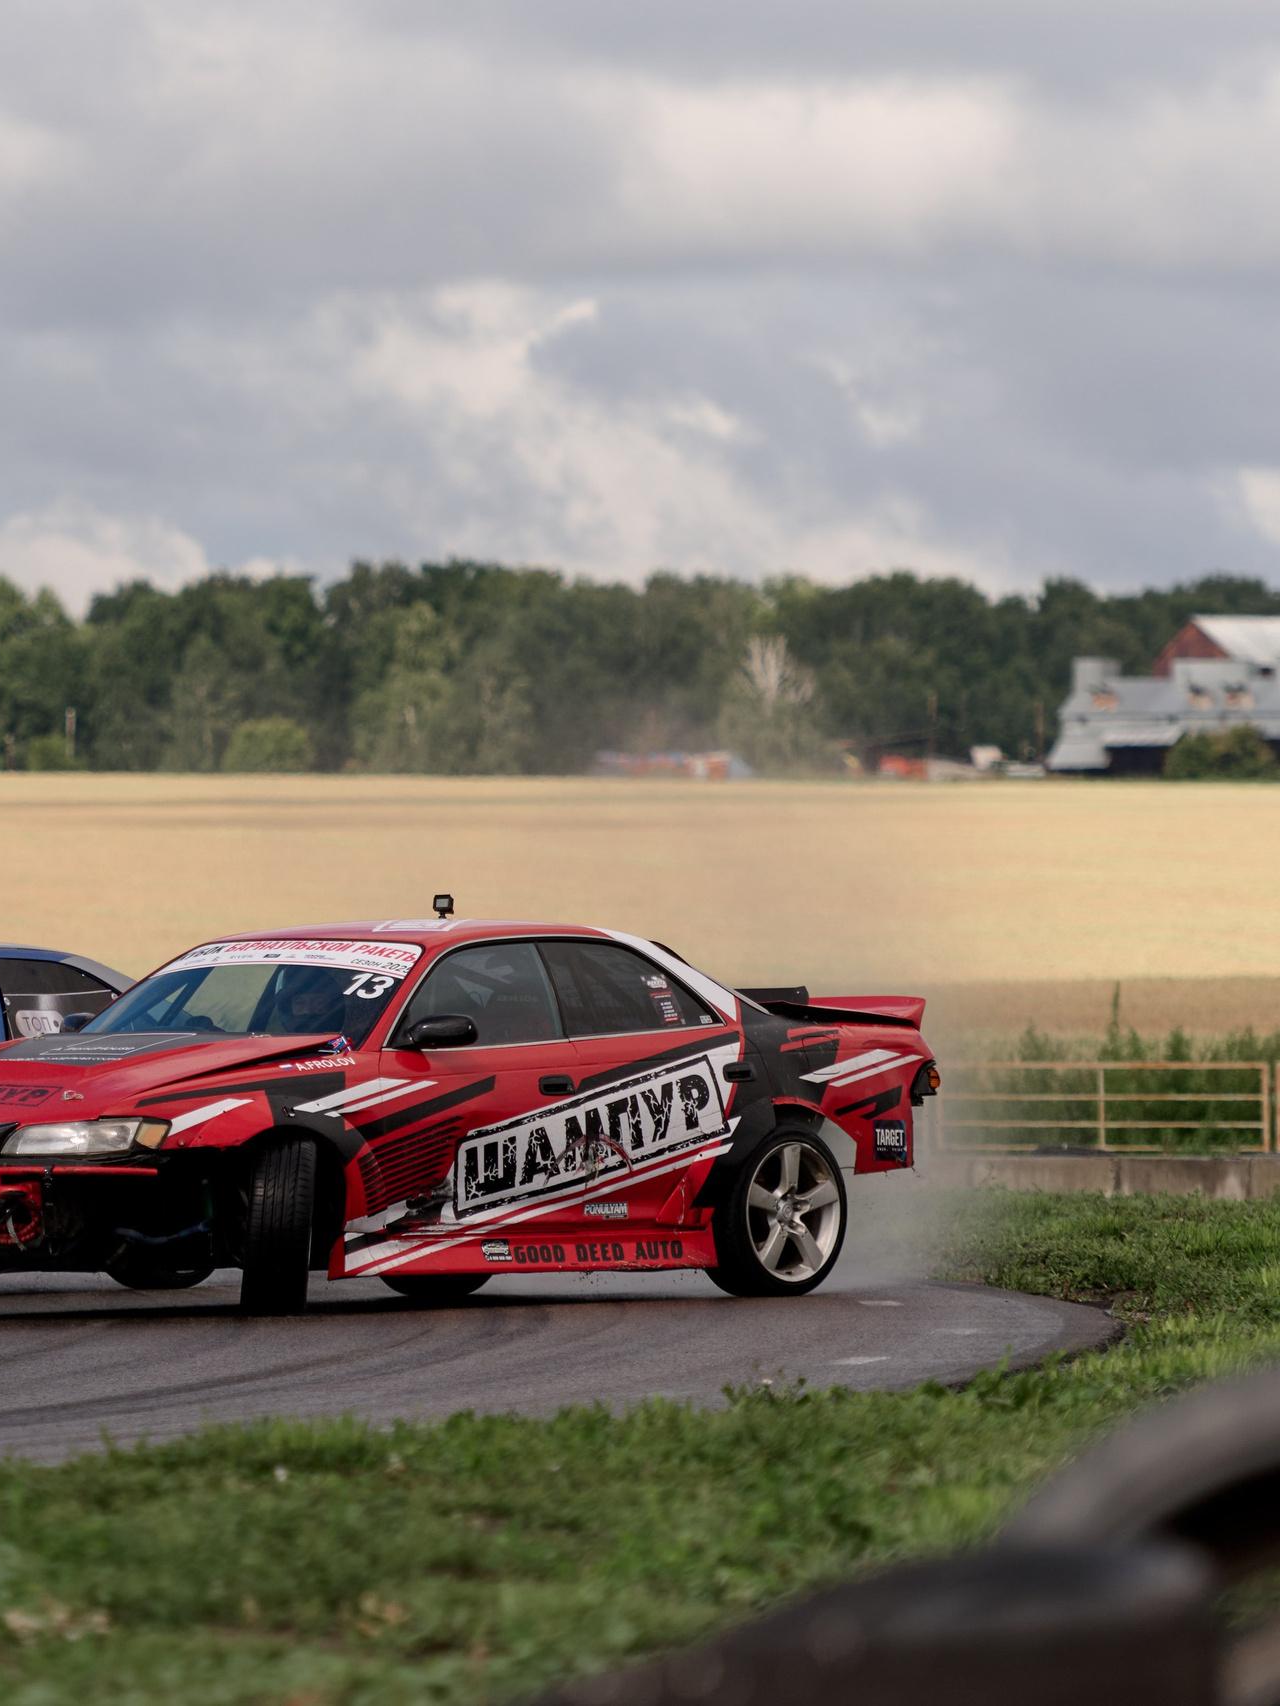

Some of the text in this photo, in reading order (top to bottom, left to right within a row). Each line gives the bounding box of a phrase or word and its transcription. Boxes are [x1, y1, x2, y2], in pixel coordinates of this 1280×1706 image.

[224, 941, 357, 953] БАРНАУЛЬСКОЙ
[350, 958, 382, 968] СЕЗОН
[343, 972, 395, 999] 13
[295, 1057, 356, 1072] A.FROLOV
[464, 1074, 710, 1202] ШАМПУР
[875, 1128, 904, 1147] TARGET
[584, 1202, 628, 1217] PONULYAM
